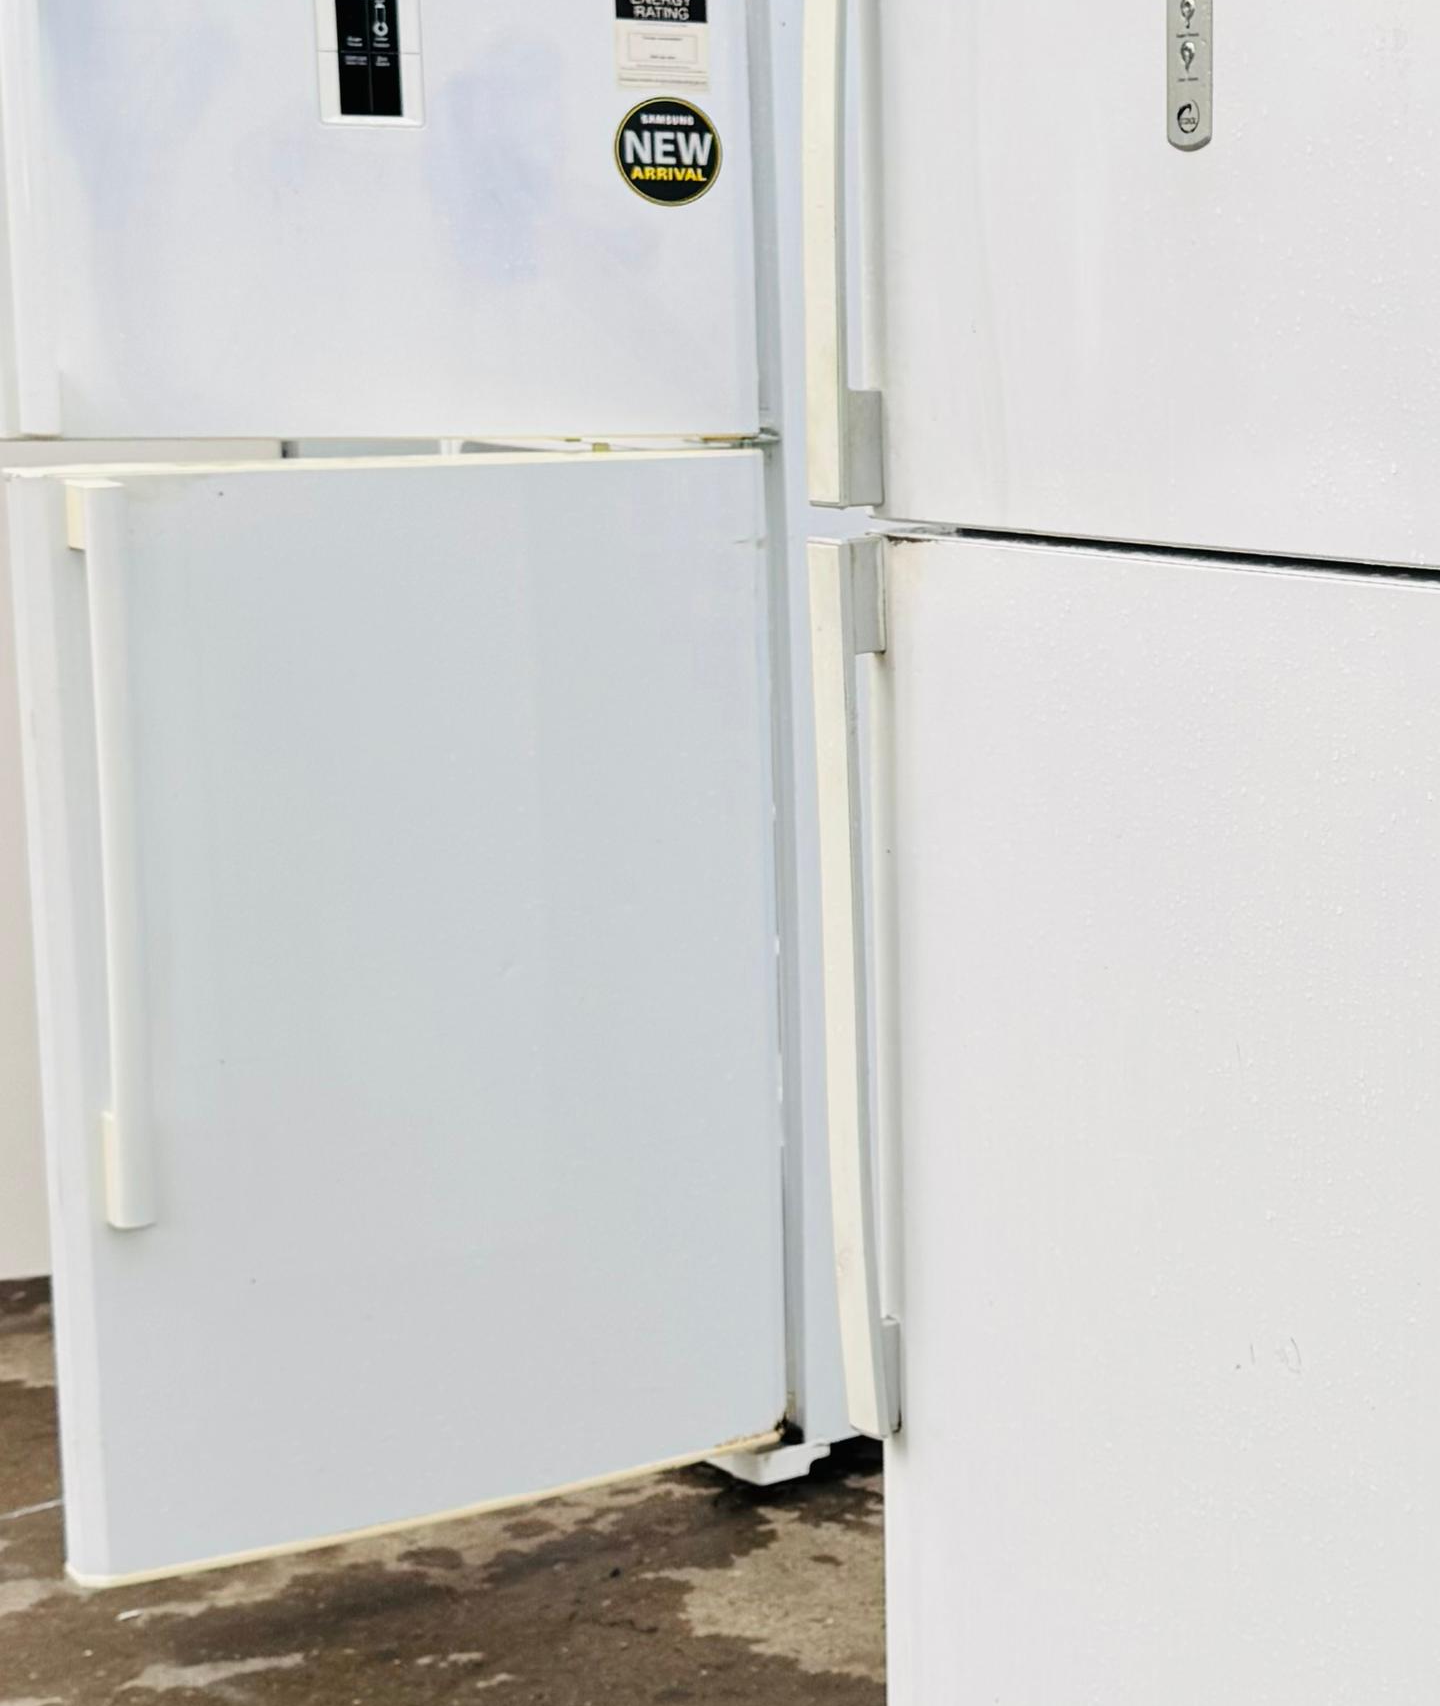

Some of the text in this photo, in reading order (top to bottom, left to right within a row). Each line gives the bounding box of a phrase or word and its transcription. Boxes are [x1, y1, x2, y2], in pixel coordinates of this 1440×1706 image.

[633, 5, 690, 21] RATING
[640, 114, 695, 126] SAMSUNG
[623, 129, 713, 166] NEW
[630, 166, 708, 182] ARRIVAL
